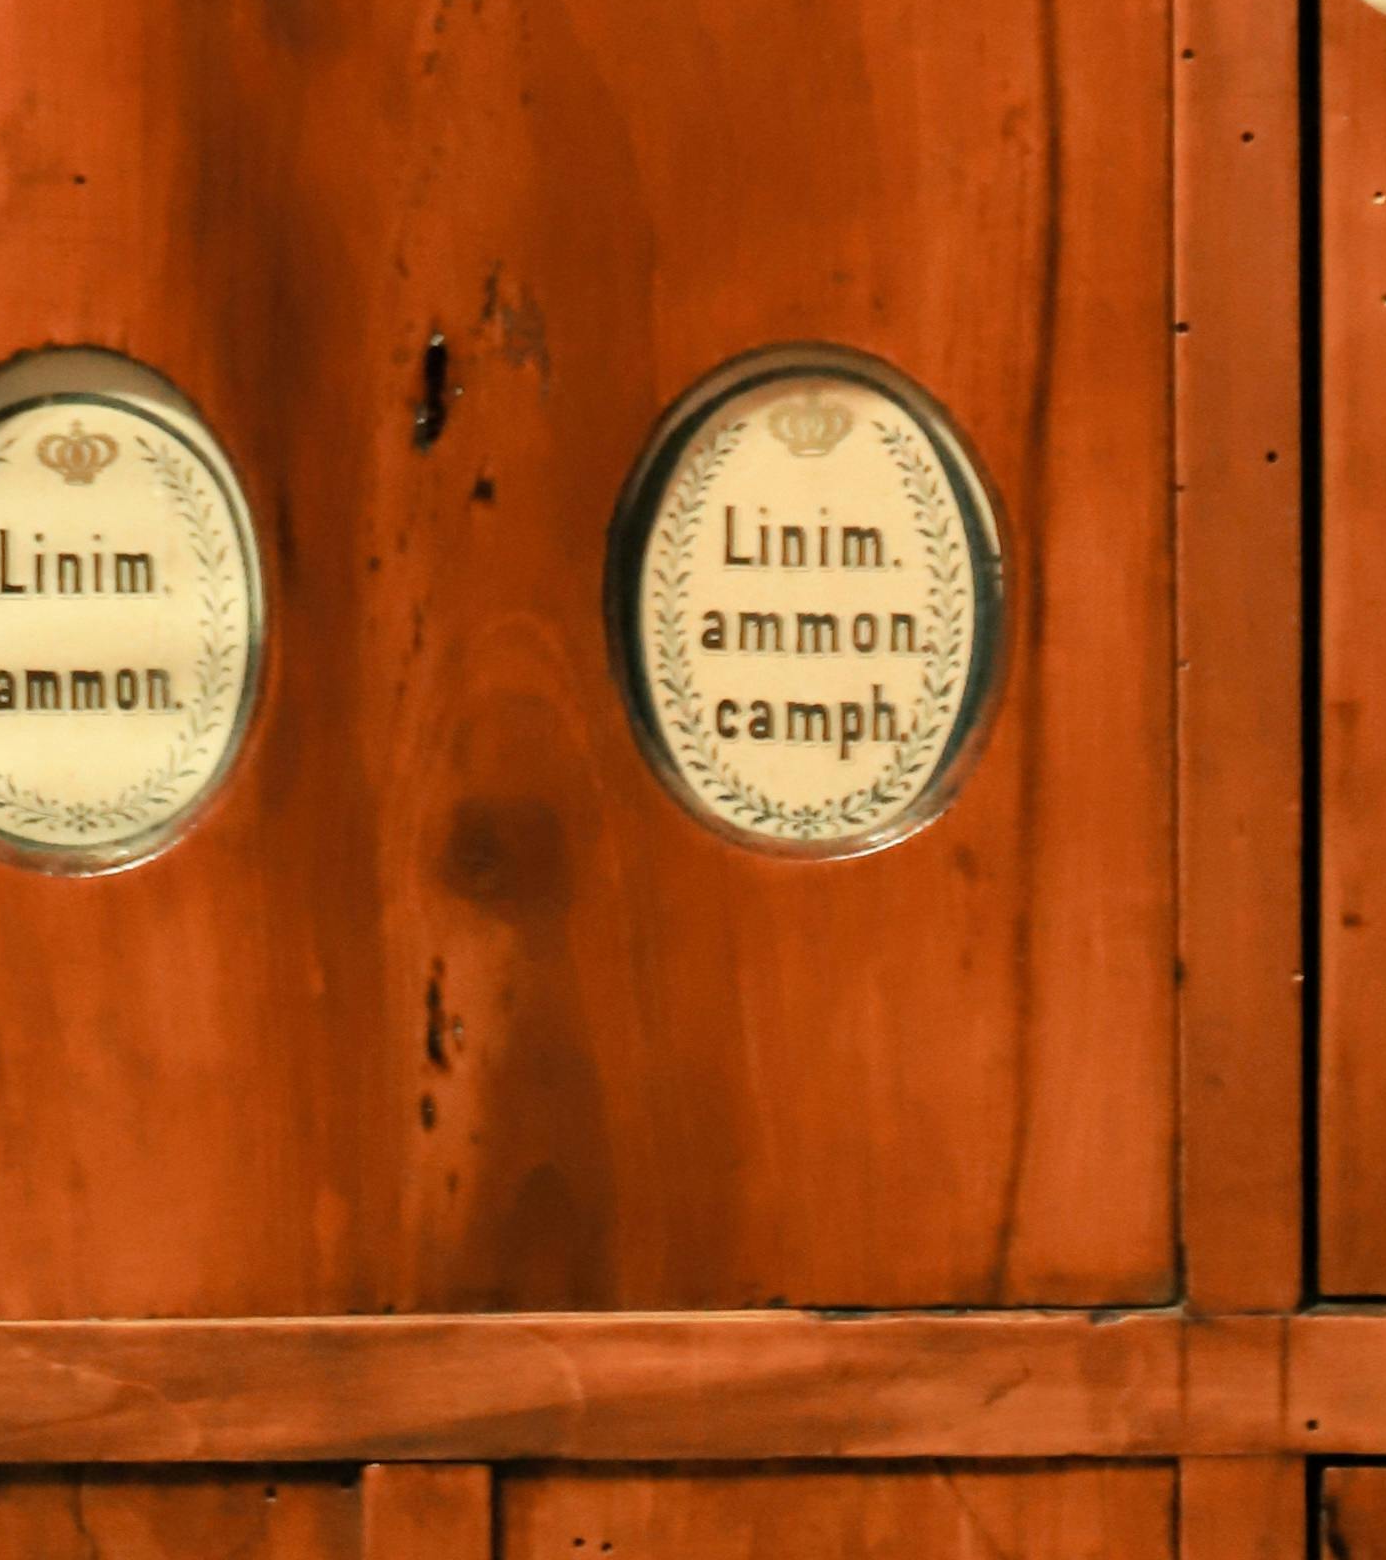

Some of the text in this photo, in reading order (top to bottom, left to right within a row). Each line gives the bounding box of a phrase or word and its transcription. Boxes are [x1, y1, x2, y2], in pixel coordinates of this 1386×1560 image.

[723, 505, 902, 568] Linim.
[700, 608, 934, 654] ammon.
[714, 684, 909, 759] camph.
